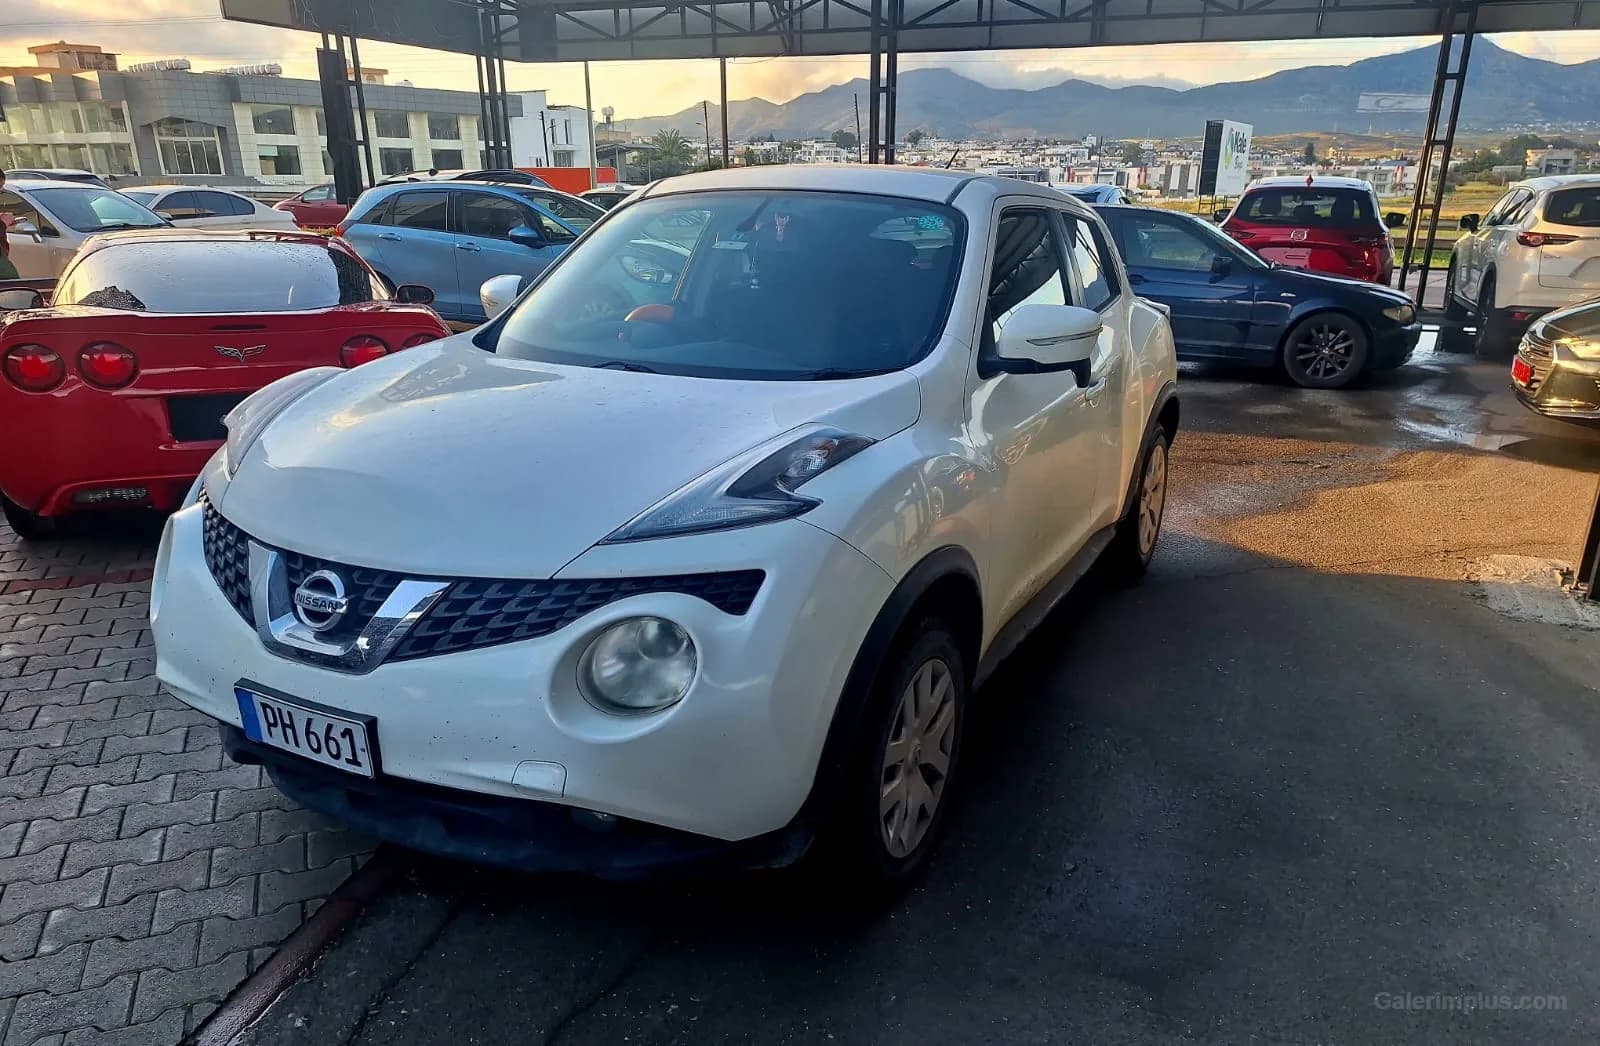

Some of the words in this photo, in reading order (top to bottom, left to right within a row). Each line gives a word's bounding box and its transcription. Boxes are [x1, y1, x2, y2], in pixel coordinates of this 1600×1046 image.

[296, 593, 337, 611] NISSAN
[260, 701, 300, 748] PH
[305, 717, 362, 768] 661
